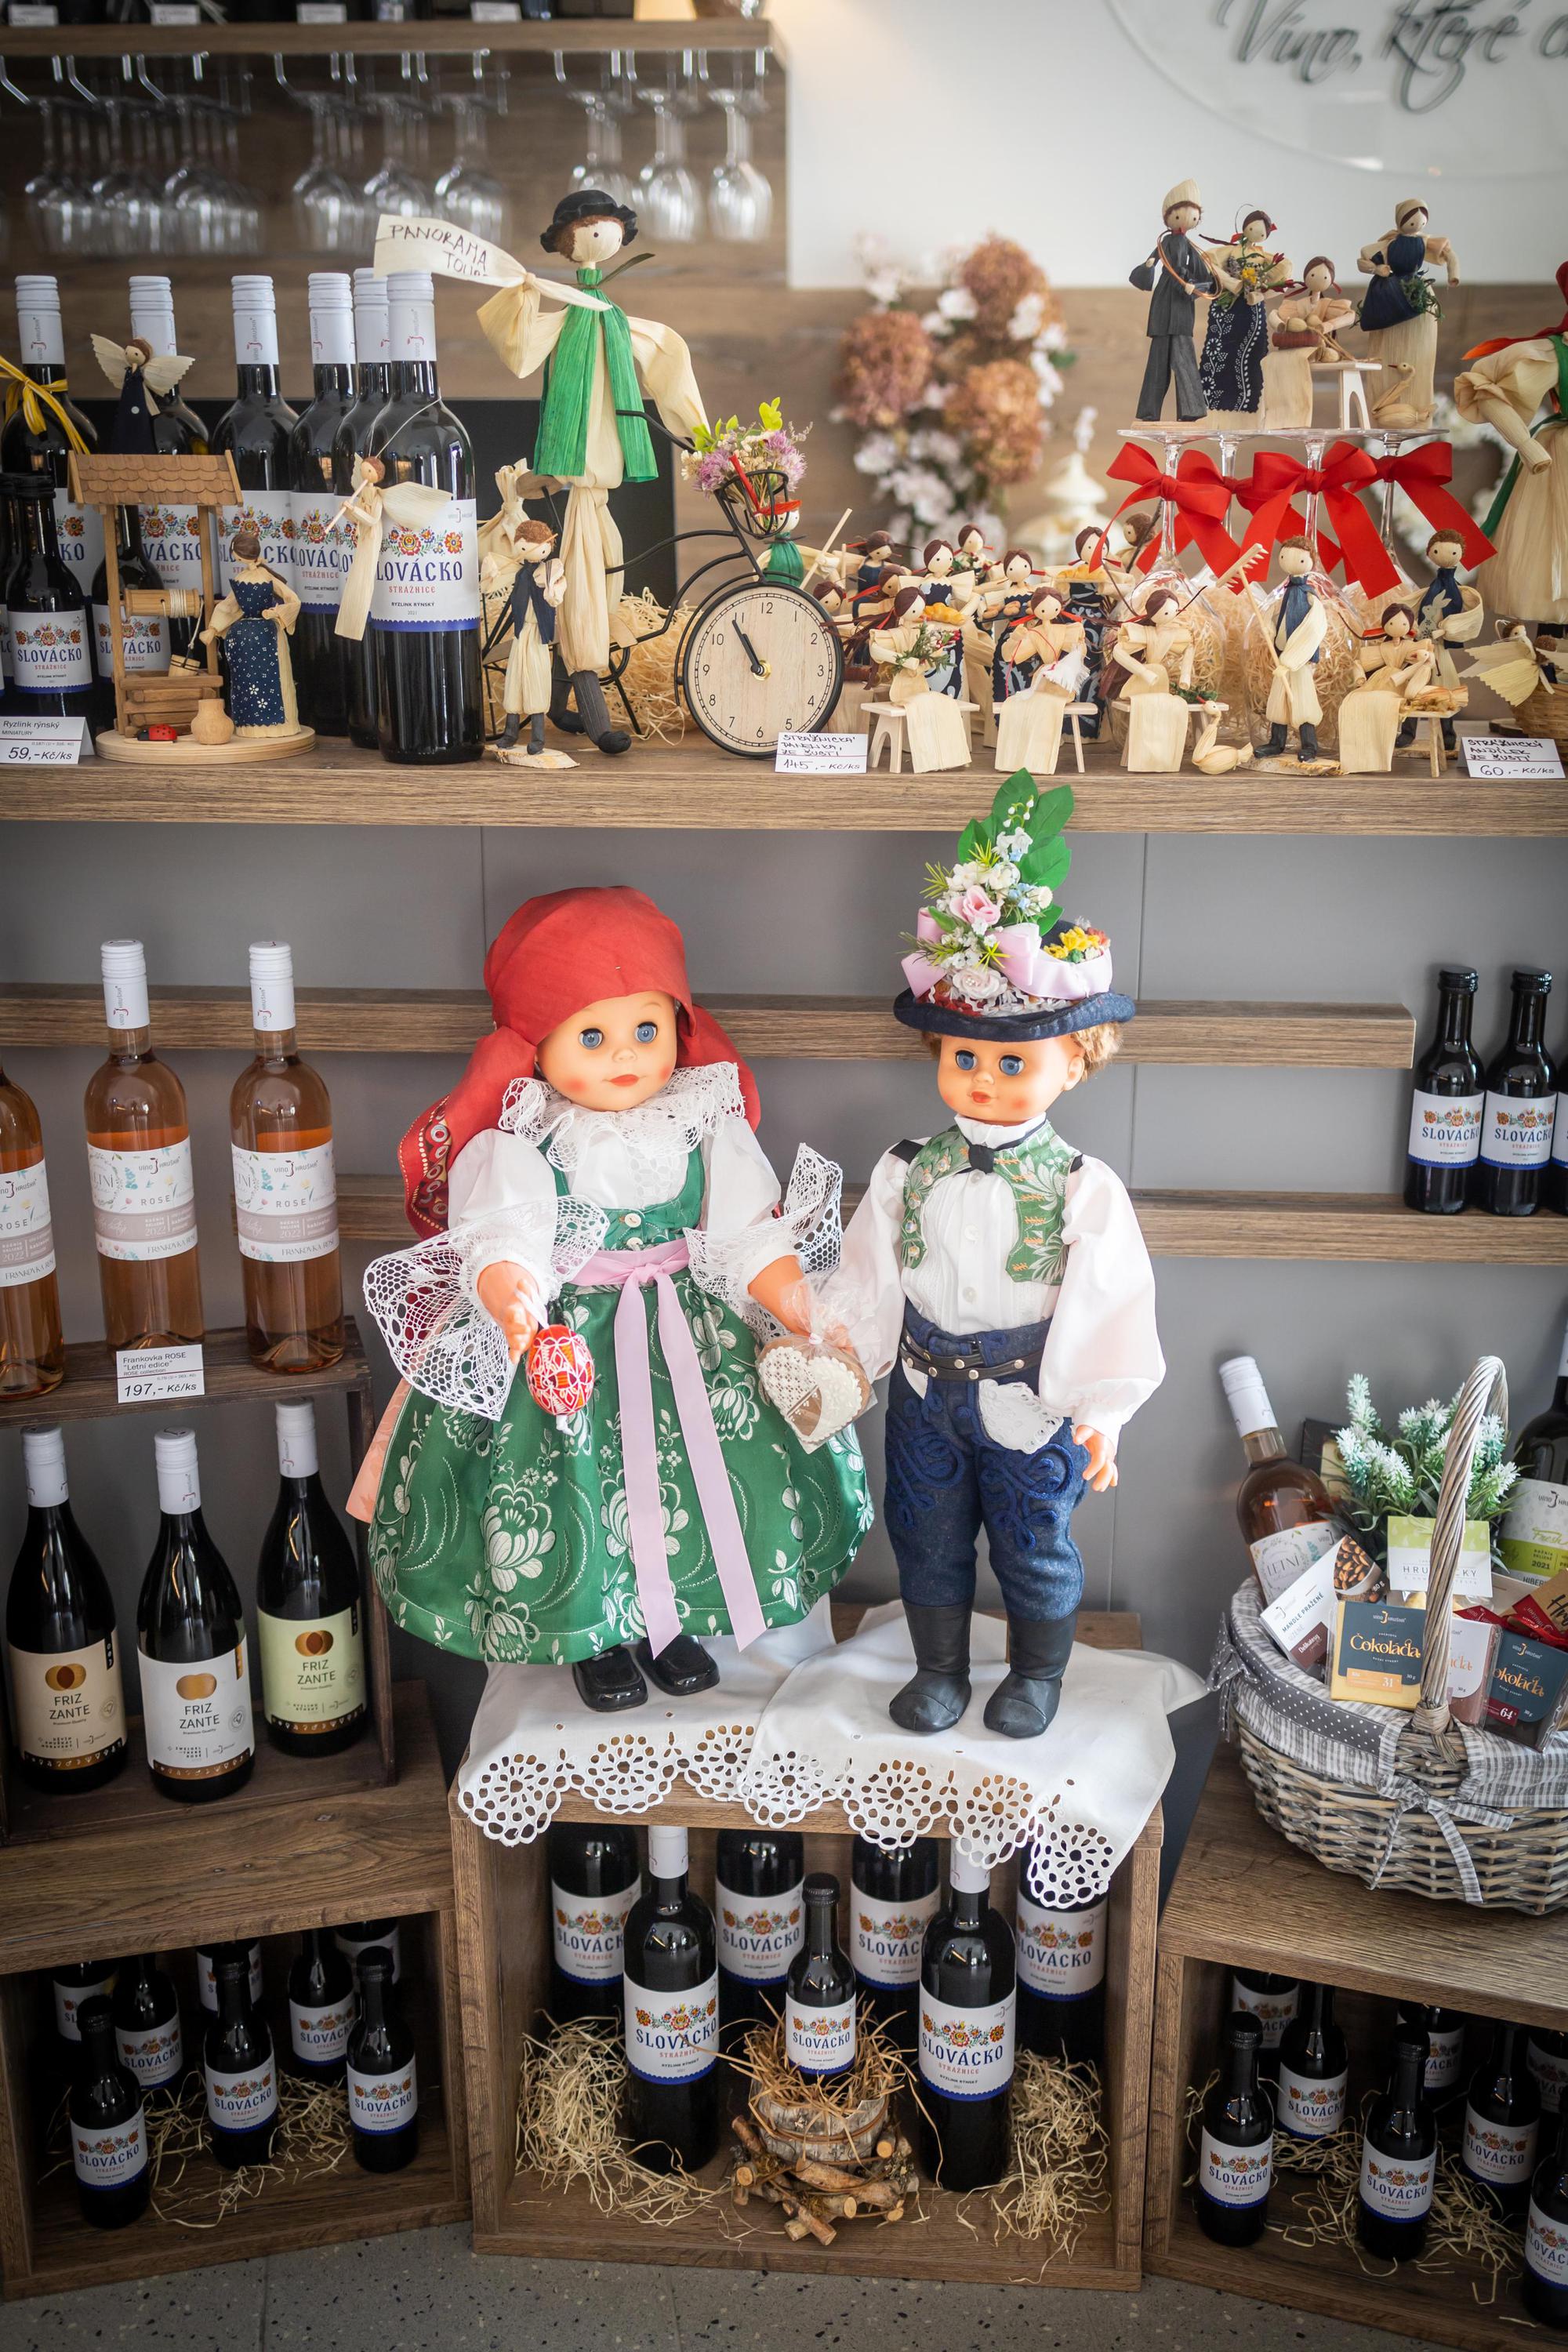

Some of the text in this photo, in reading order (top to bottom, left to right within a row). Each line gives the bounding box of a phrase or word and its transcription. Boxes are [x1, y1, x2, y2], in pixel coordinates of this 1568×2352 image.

[390, 225, 487, 271] PANORAMA
[377, 558, 463, 582] LOVÁCKO
[761, 602, 773, 614] 12
[712, 633, 724, 645] 10
[811, 633, 818, 644] 2
[17, 648, 82, 662] SLOVÁCKO
[702, 665, 710, 676] 9
[817, 666, 825, 677] 3
[709, 695, 716, 706] 8
[808, 695, 815, 706] 4
[3, 720, 31, 729] Ryzlink
[729, 717, 735, 728] 7
[786, 719, 793, 730] 5
[757, 727, 764, 738] 6
[280, 1229, 301, 1238] 2022
[123, 1355, 162, 1363] Frankovka
[125, 1383, 197, 1396] 197,- Kč/ks
[1532, 1561, 1550, 1570] 2021
[1282, 1613, 1302, 1632] MANDLE
[1350, 1633, 1421, 1658] Čokoláda
[303, 1660, 329, 1671] FRIZ
[297, 1671, 336, 1685] ZANTE
[1382, 1677, 1393, 1687] 31
[1493, 1668, 1544, 1697] okoláda
[54, 1693, 82, 1706] FRIZ
[49, 1704, 90, 1719] ZANTE
[184, 1703, 212, 1715] FRIZ
[1500, 1708, 1513, 1720] 64
[180, 1714, 220, 1729] ZANTE
[557, 1927, 623, 1952] SLOVÁCK
[723, 1927, 800, 1952] SLOVÁCKO
[636, 2017, 717, 2049] SLOVÁCKO
[793, 2031, 850, 2049] SLOVÁCKO
[922, 2032, 1003, 2066] SLOVÁCKO
[214, 2086, 272, 2111] SLOVÁCKO
[354, 2091, 412, 2114] SLOVÁCKO
[79, 2143, 140, 2167] SLOVÁCKO
[1209, 2165, 1268, 2186] SLOVÁCKO
[1367, 2175, 1428, 2199] SLOVÁCKO
